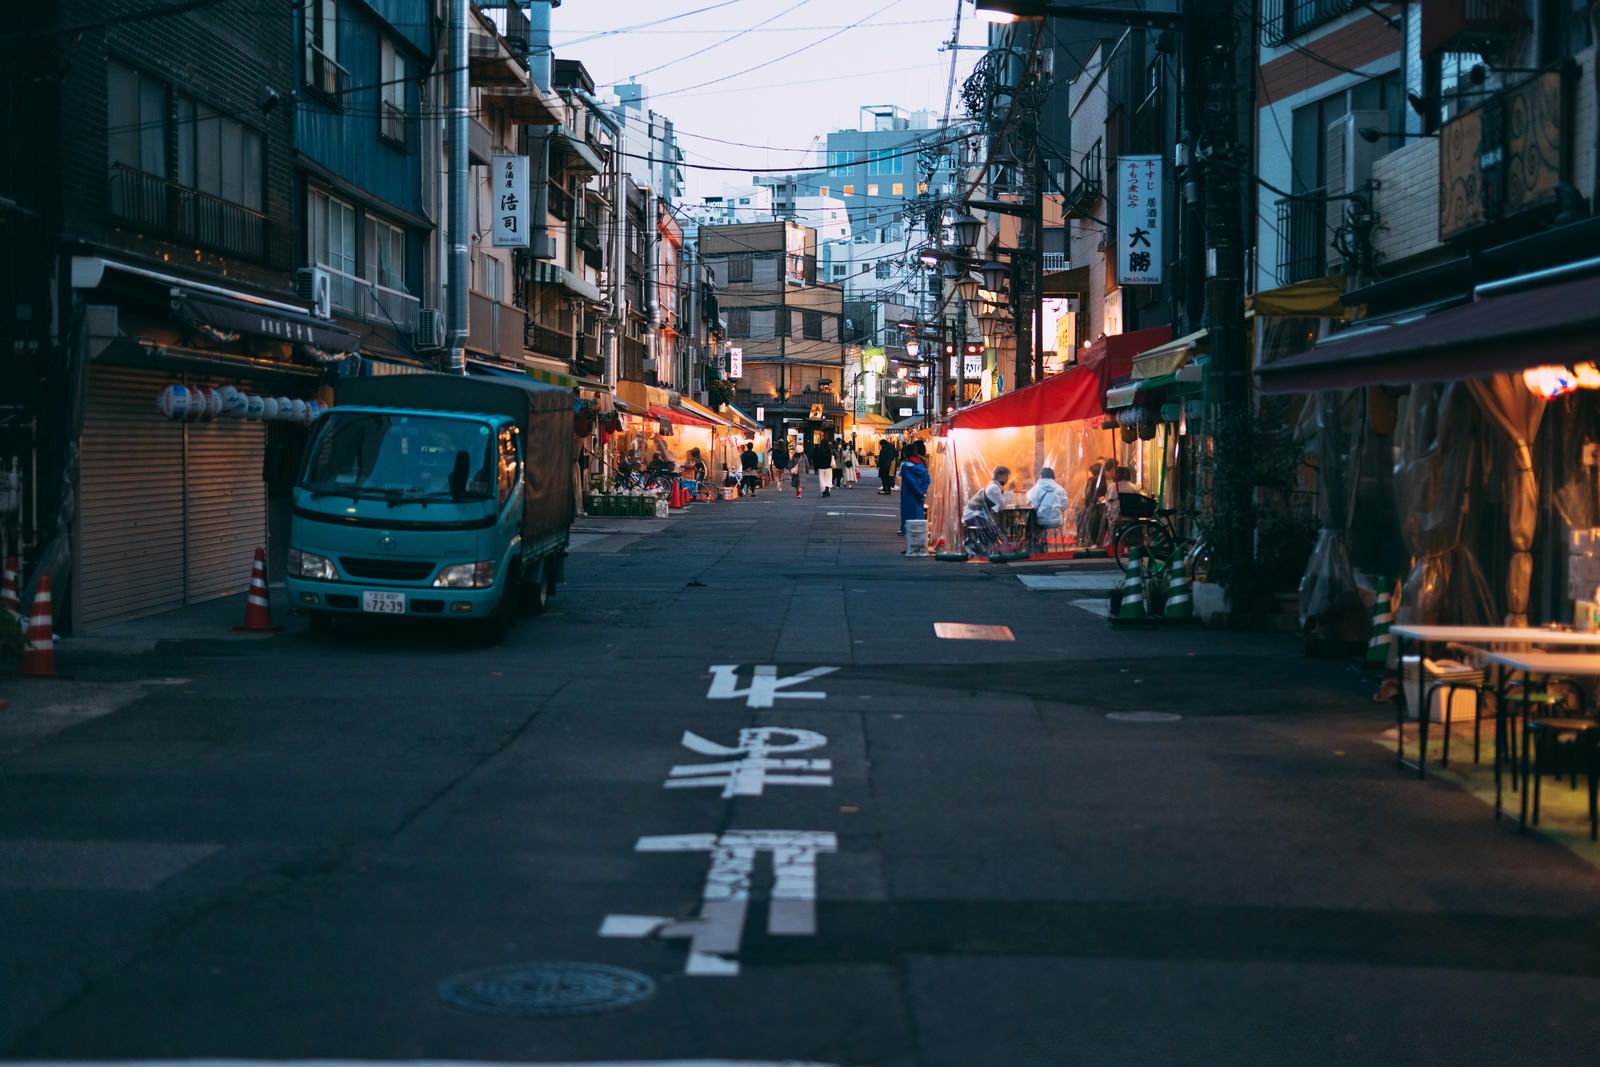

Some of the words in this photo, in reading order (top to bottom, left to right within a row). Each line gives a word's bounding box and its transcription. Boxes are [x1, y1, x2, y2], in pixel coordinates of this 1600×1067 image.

[505, 161, 514, 189] 居酒屋
[501, 193, 519, 233] 浩司
[1146, 197, 1157, 229] 居酒屋
[1129, 226, 1151, 272] 大勝
